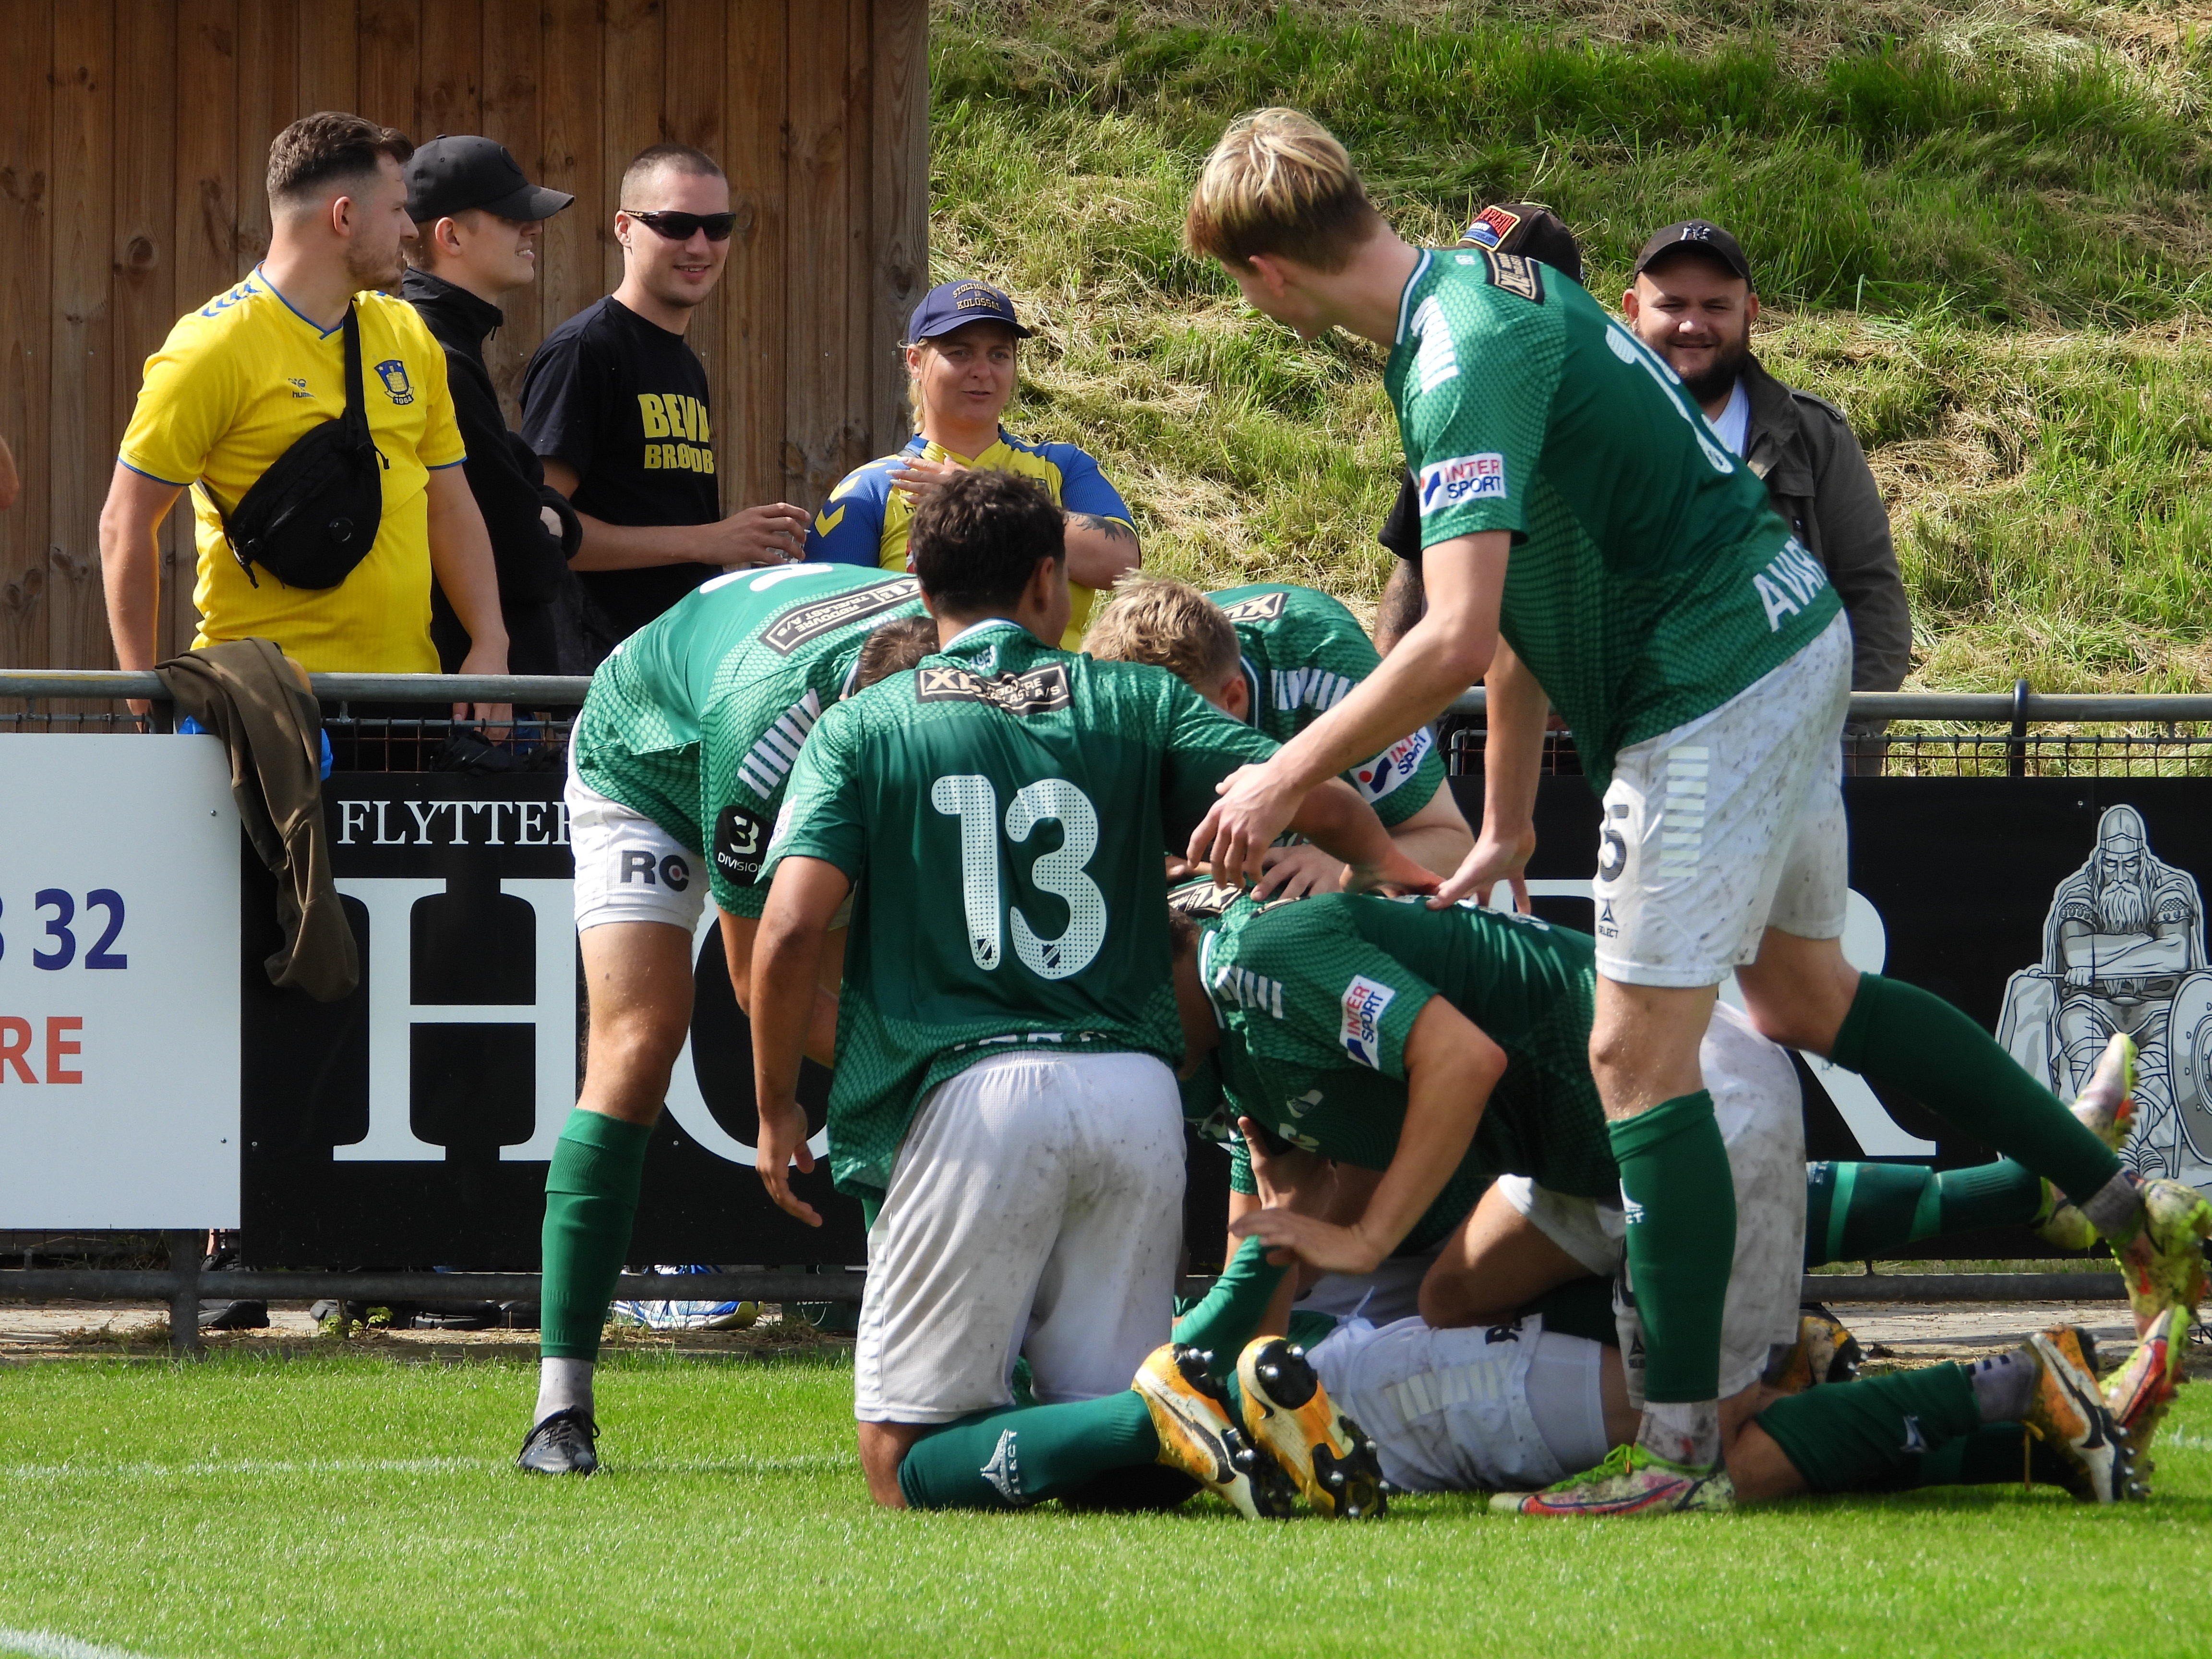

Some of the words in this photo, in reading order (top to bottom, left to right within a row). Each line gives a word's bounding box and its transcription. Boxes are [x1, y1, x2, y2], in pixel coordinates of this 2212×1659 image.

[956, 298, 1002, 312] KOLOSSAL
[395, 396, 413, 404] 1964
[1443, 459, 1500, 483] INTER
[1447, 476, 1501, 499] SPORT
[1035, 685, 1061, 698] A/S
[730, 815, 759, 854] 3
[931, 774, 1107, 980] 13
[33, 888, 128, 971] 32
[1346, 985, 1370, 1037] INTER
[1360, 990, 1383, 1044] SPORT
